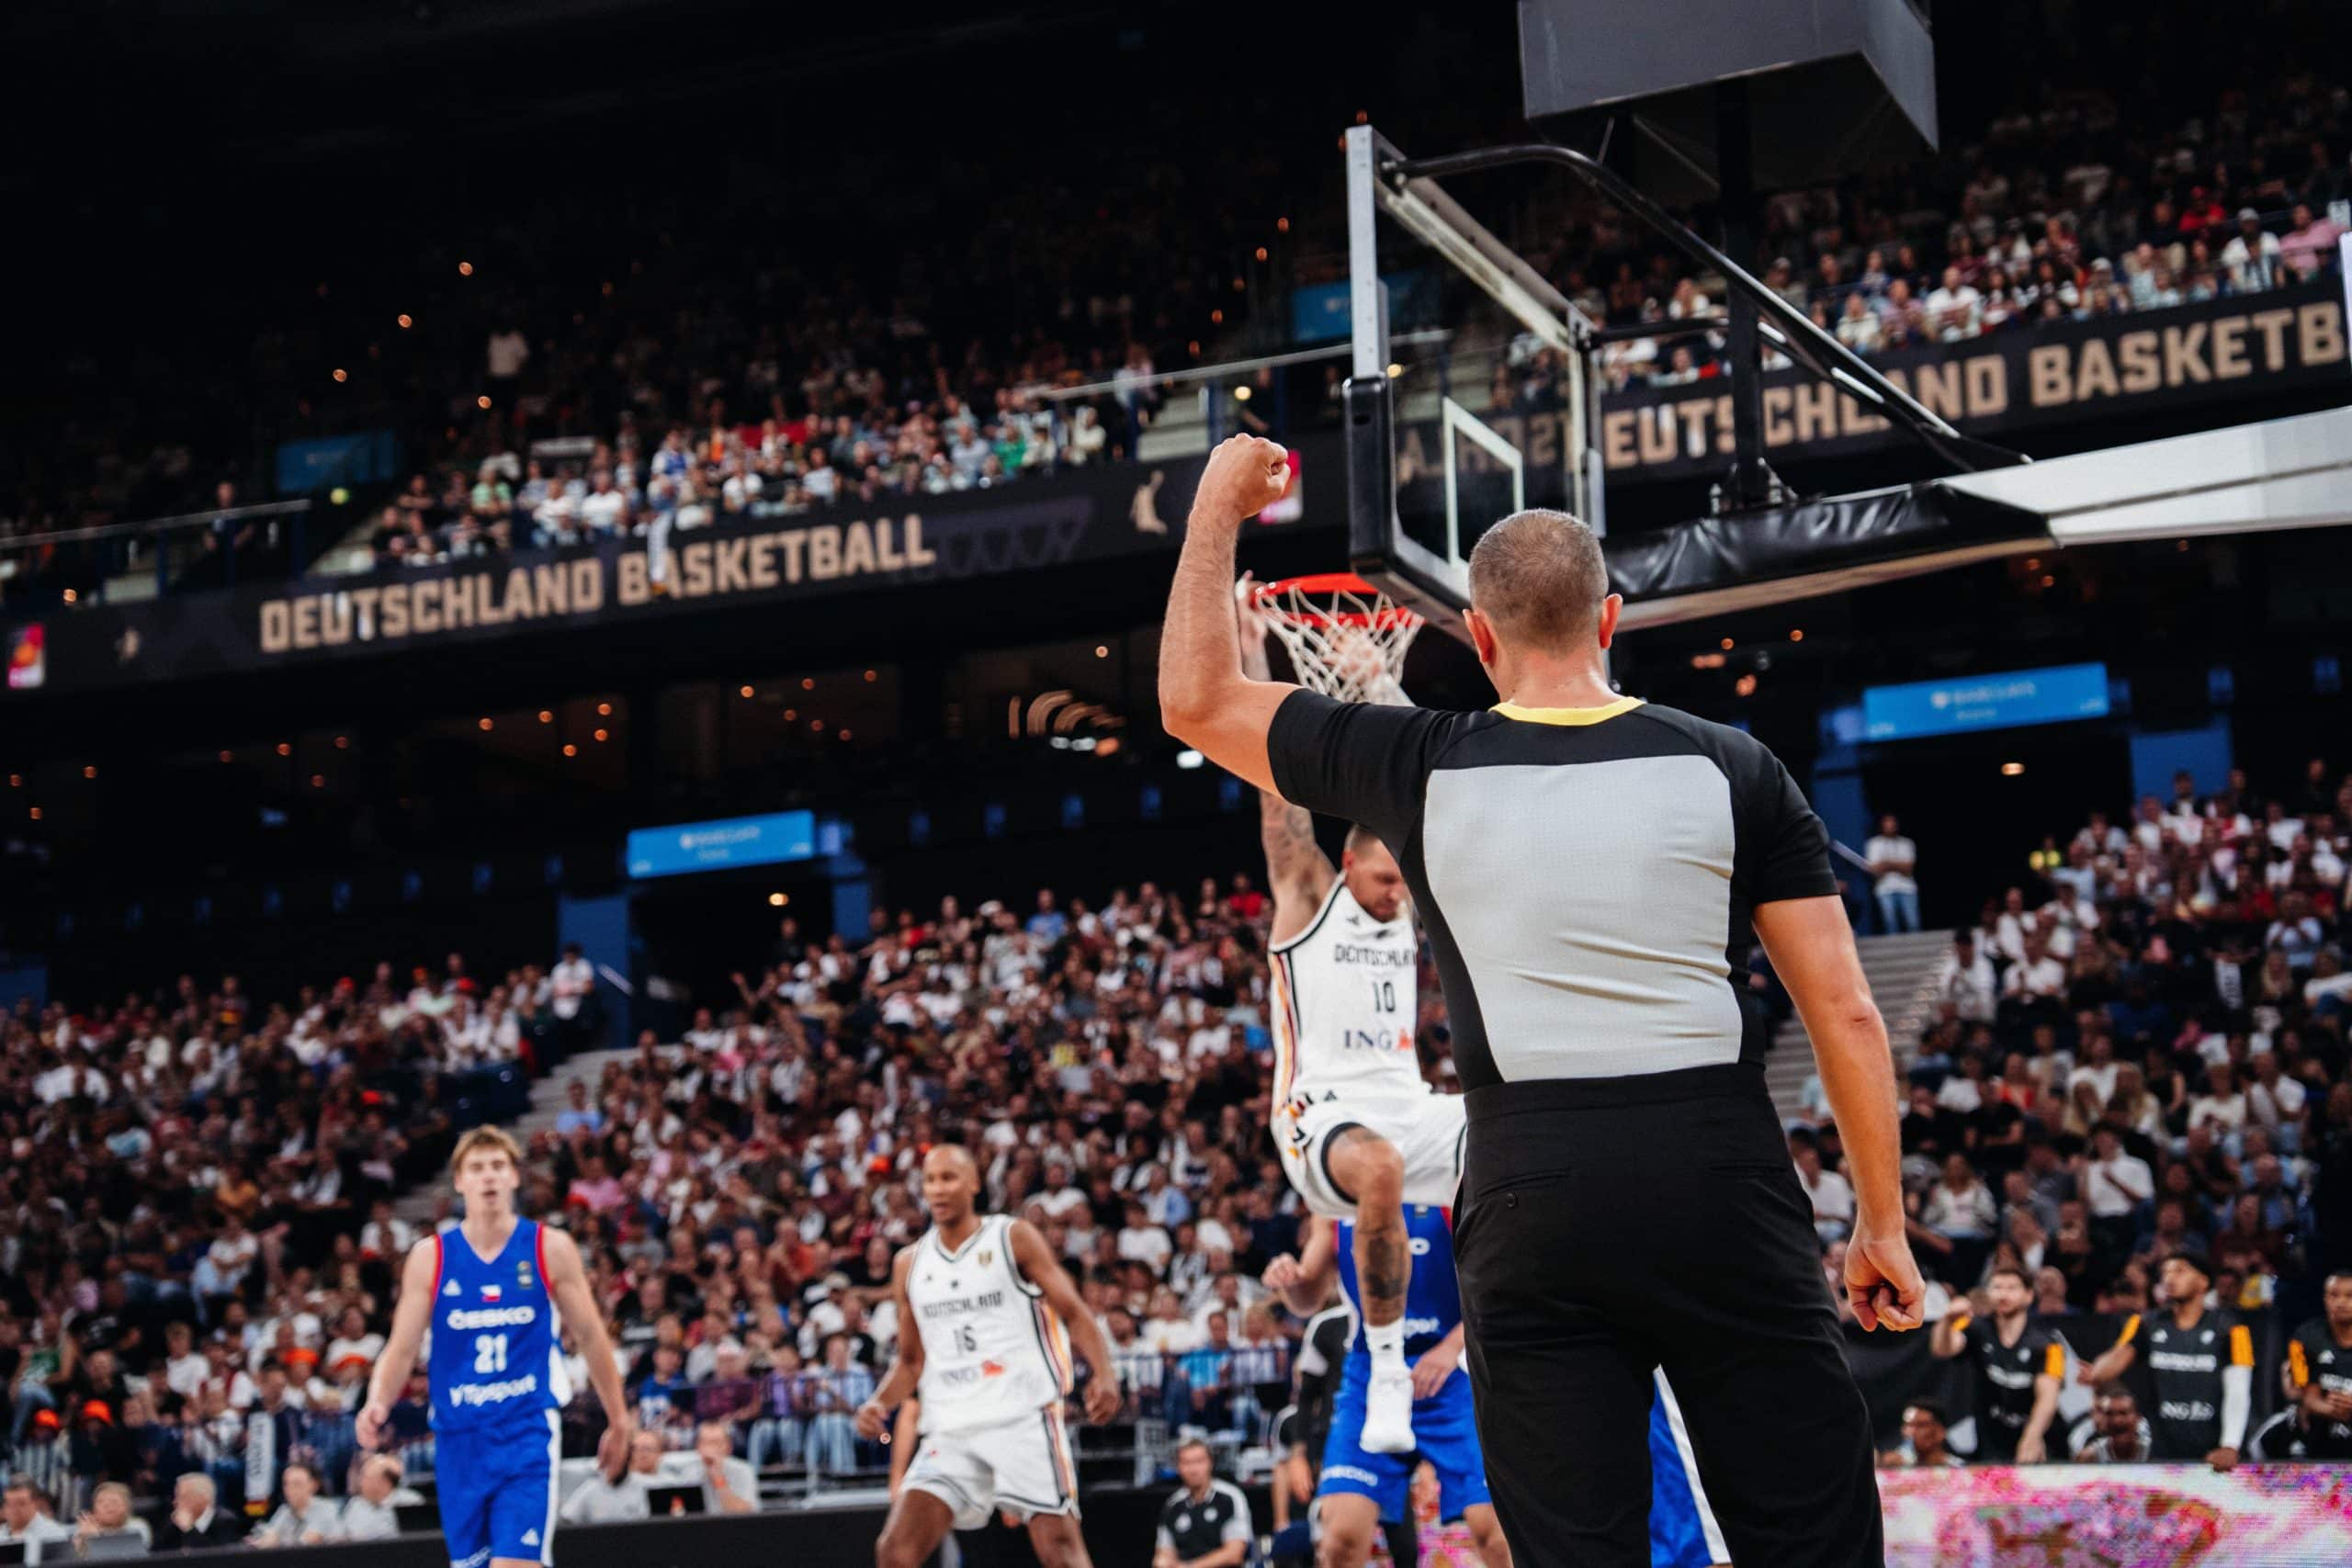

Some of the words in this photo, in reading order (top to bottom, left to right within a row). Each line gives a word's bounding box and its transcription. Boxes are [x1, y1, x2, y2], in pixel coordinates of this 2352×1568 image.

[260, 557, 604, 653] DEUTSCHLAND
[1373, 982, 1396, 1012] 10
[473, 1334, 509, 1374] 21
